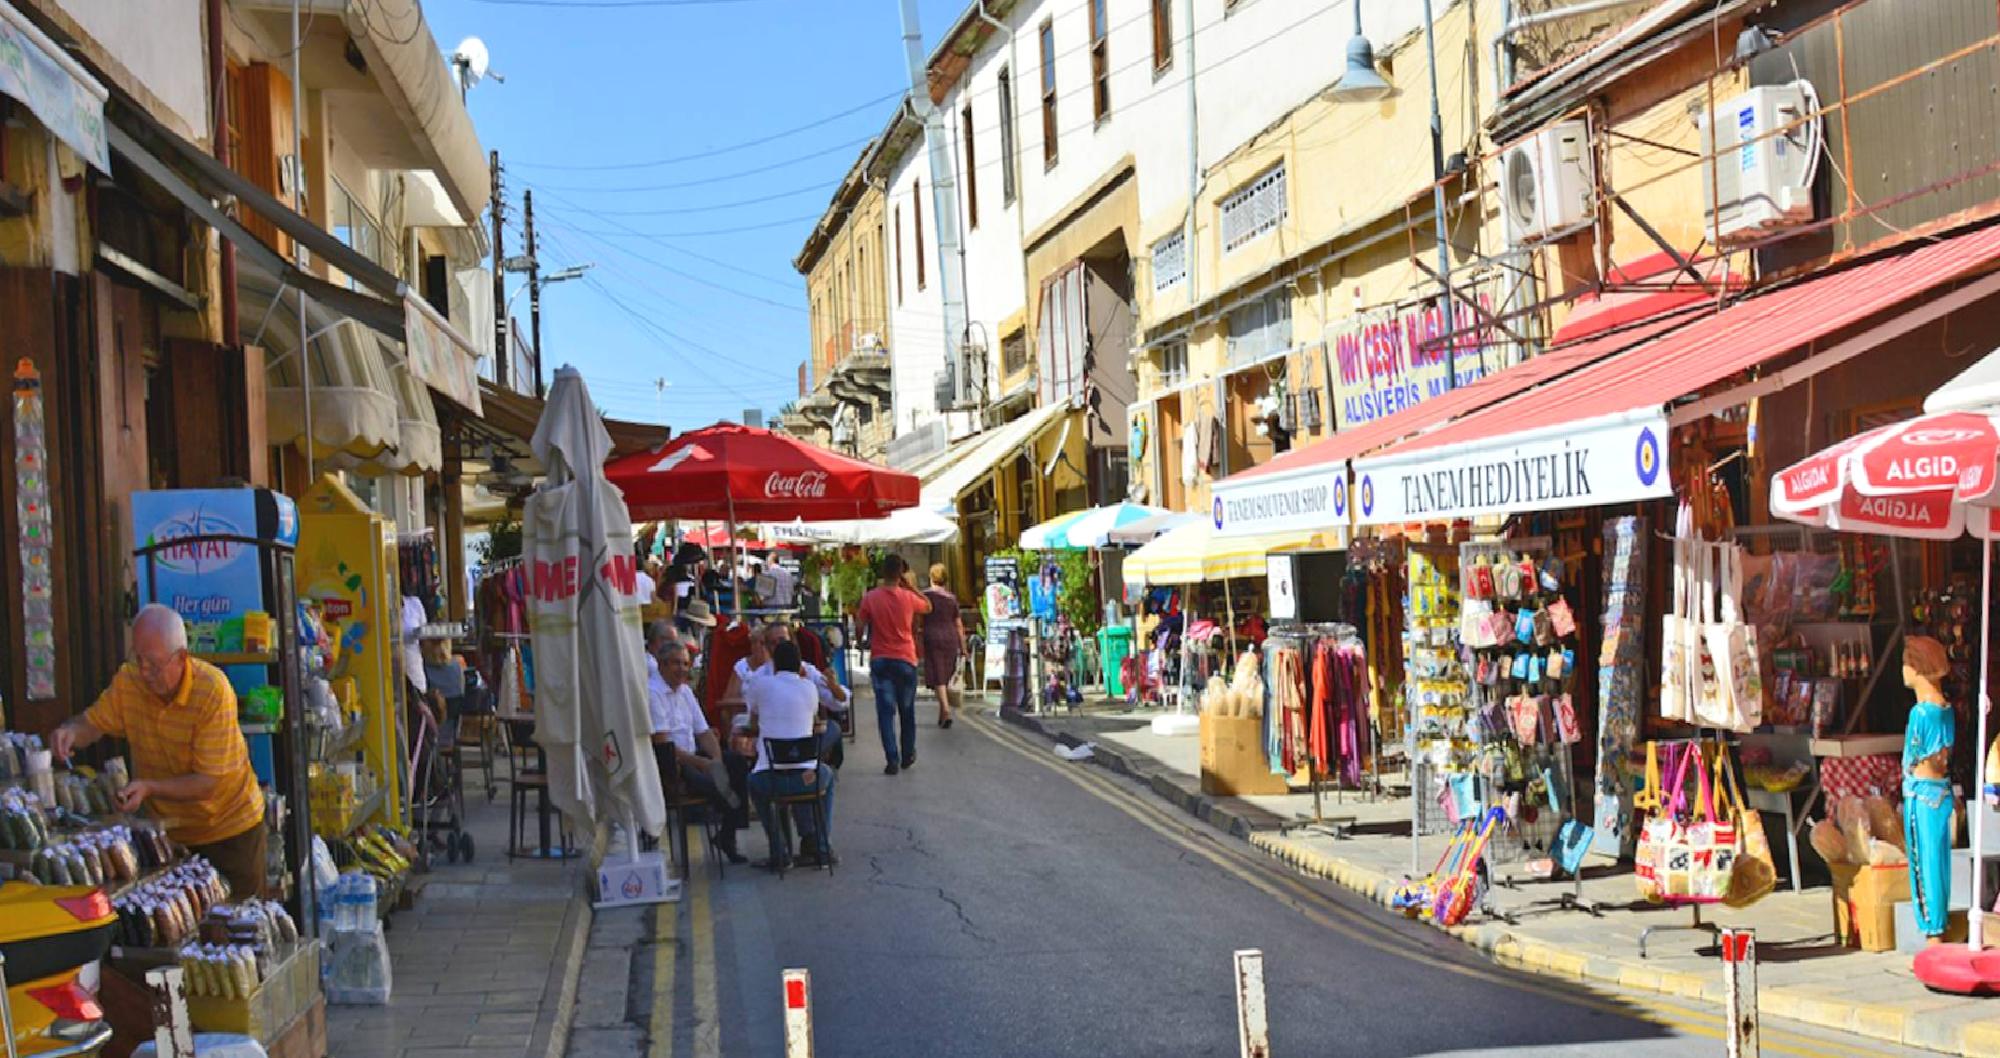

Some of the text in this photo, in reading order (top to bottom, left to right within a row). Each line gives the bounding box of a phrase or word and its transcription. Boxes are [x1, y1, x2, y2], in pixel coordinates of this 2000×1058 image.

[1302, 485, 1328, 514] SHOP
[1401, 440, 1592, 515] TANEM HEDİYELİK
